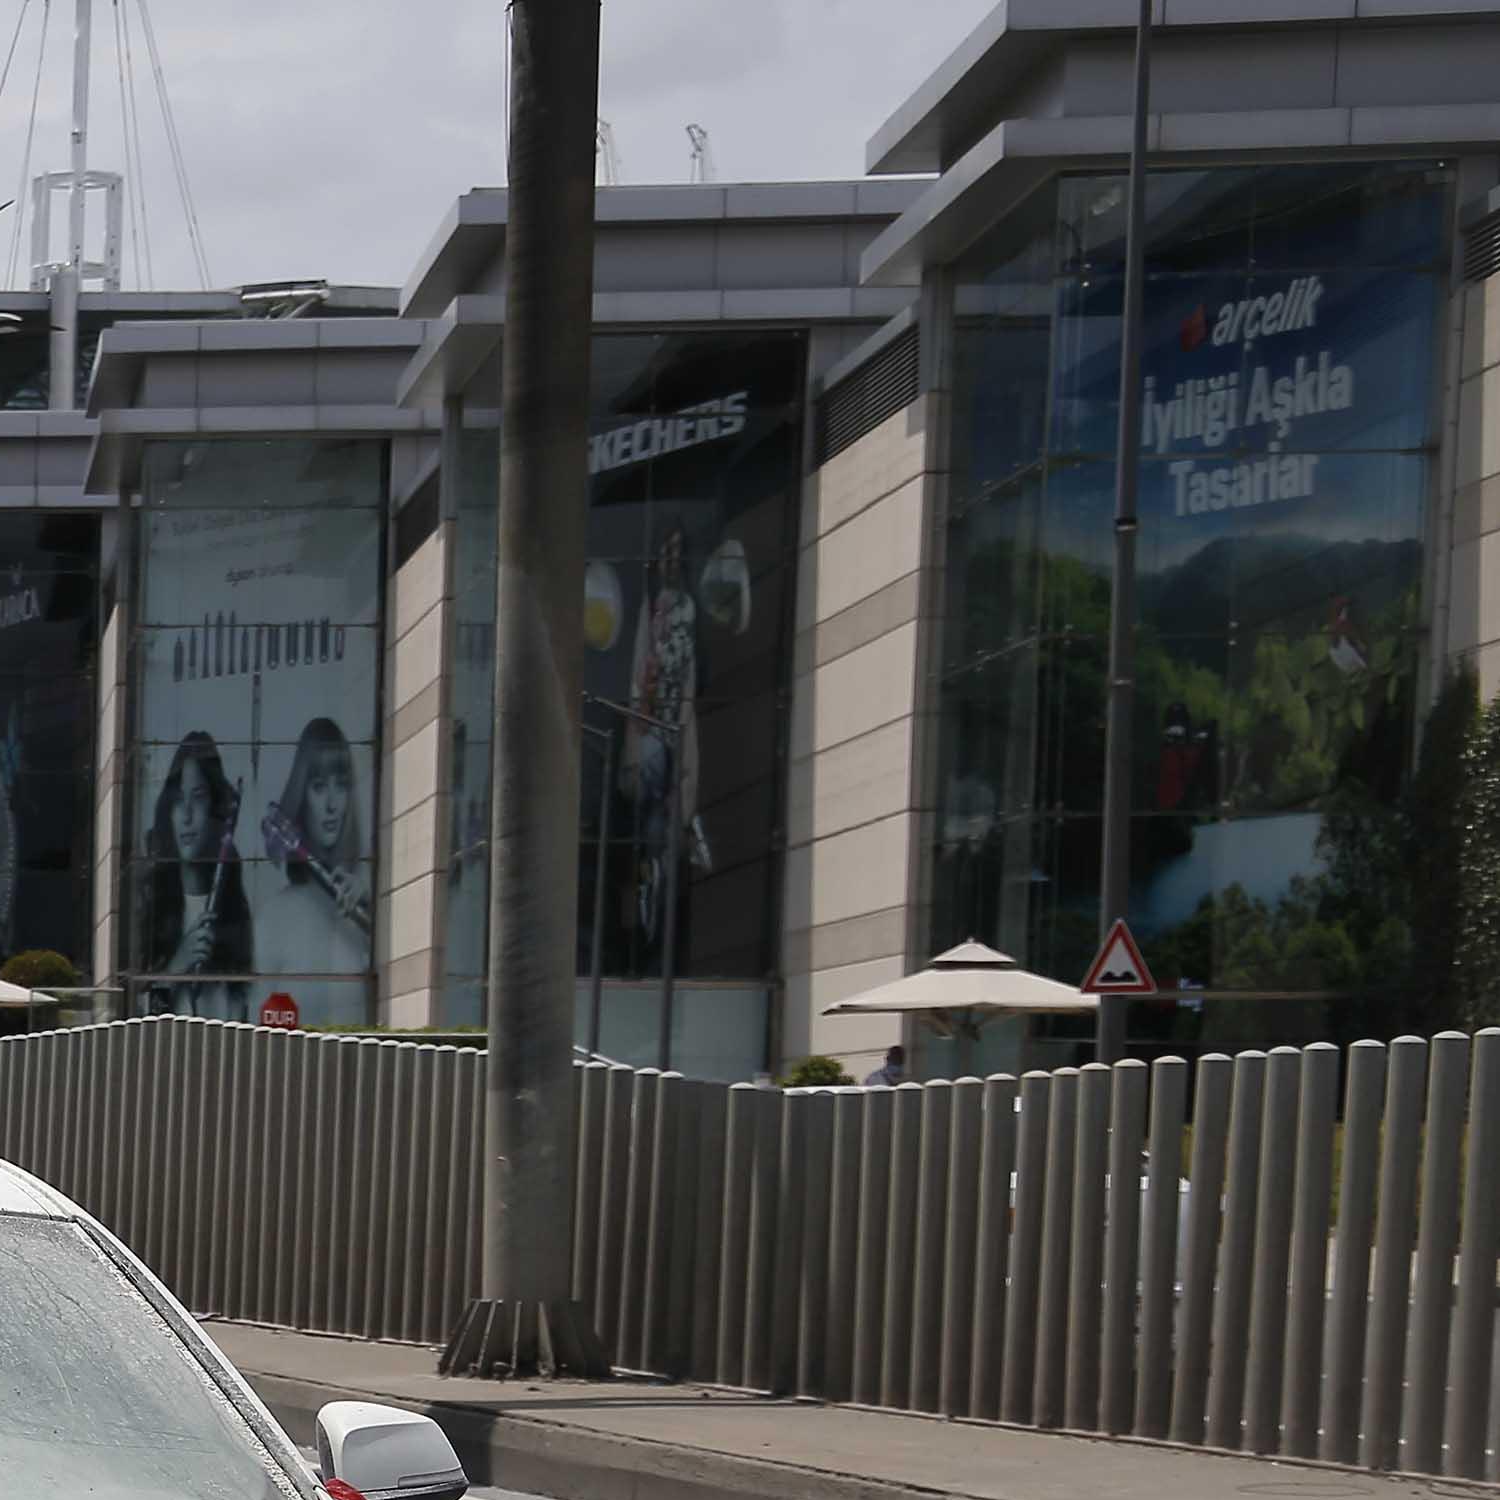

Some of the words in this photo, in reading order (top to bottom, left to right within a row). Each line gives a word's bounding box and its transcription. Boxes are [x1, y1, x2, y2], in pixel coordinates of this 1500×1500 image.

[1211, 275, 1323, 352] arçelik
[587, 390, 750, 475] KECHERS
[1140, 374, 1241, 455] İyiliği
[1244, 351, 1353, 439] Aşkla
[1168, 440, 1321, 517] Tasarlar
[263, 1009, 296, 1025] DUR
